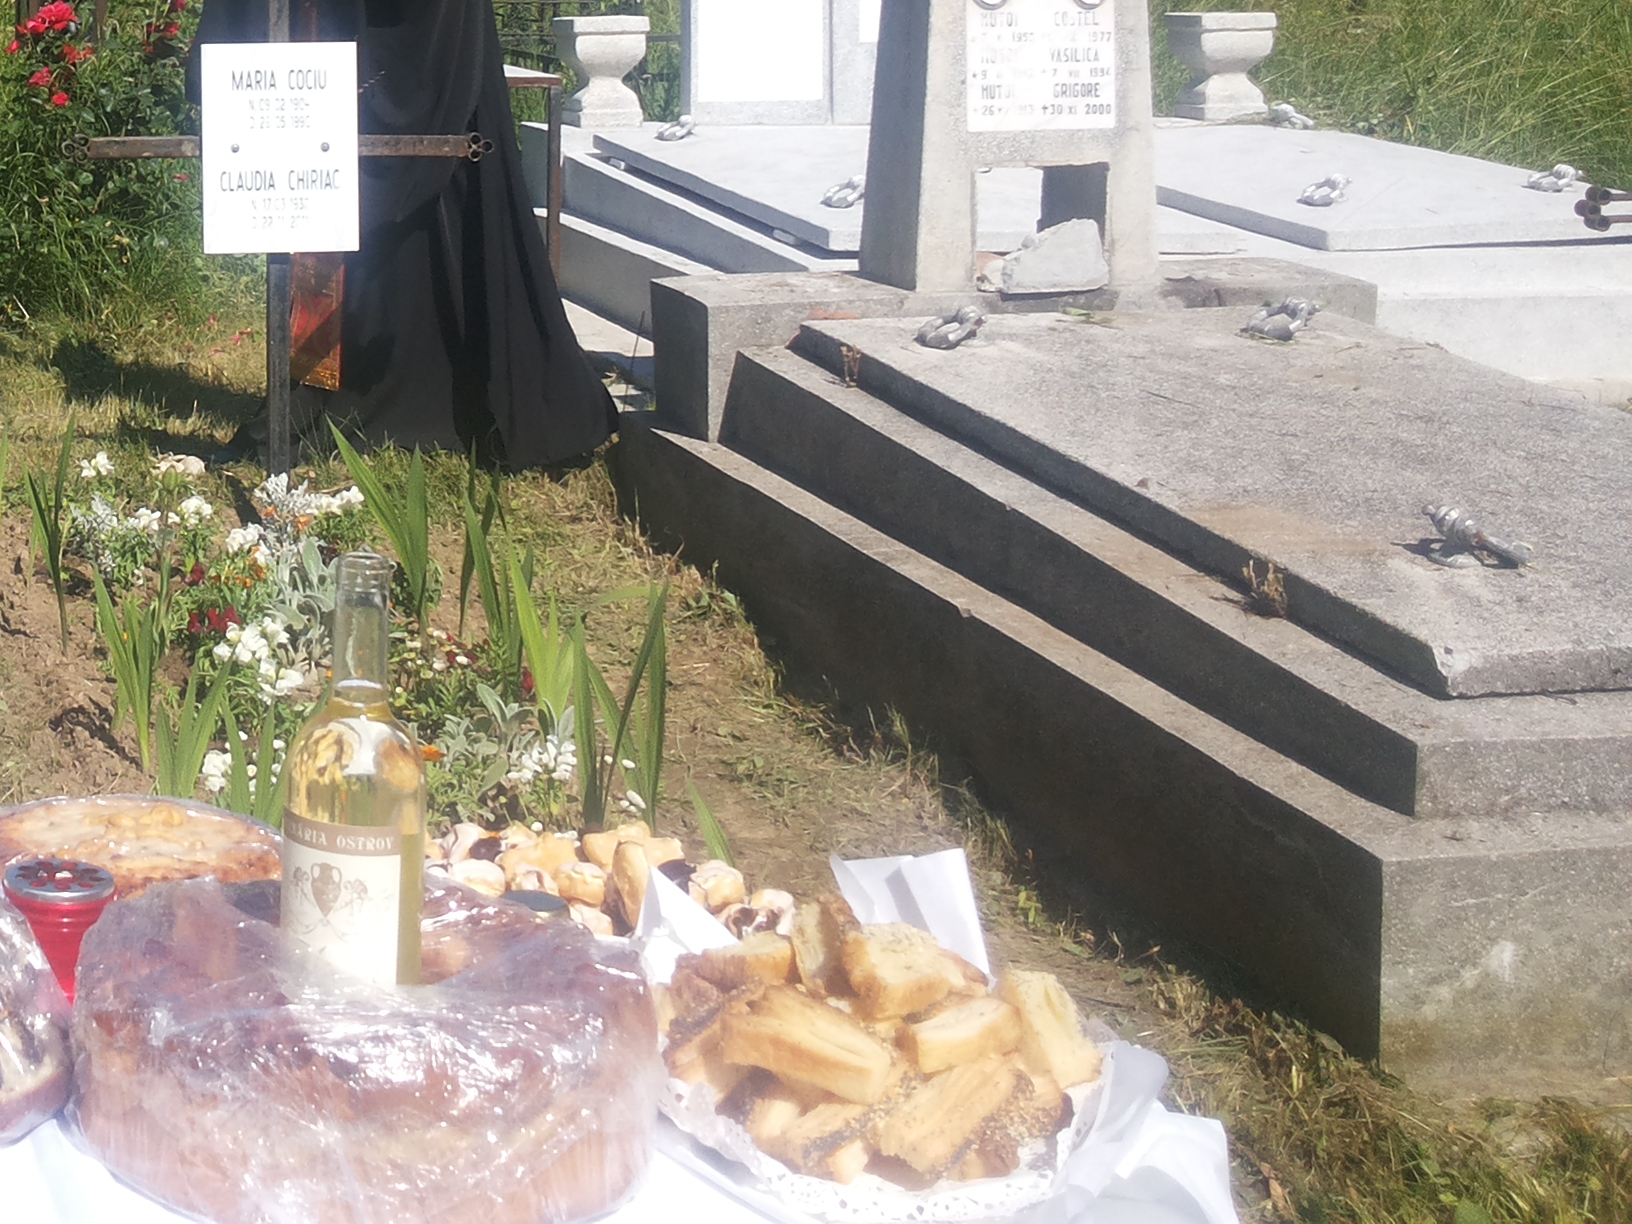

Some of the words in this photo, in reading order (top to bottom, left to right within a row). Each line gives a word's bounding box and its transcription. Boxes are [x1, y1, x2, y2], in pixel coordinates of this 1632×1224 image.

[1050, 47, 1100, 63] VASILICA
[231, 70, 277, 91] MARIA
[288, 69, 327, 90] COCIU
[1053, 82, 1101, 99] GRIGORE
[1084, 103, 1112, 115] 2000
[219, 170, 276, 192] CLAUDIA
[287, 169, 340, 191] CHIRIAC
[335, 834, 395, 851] OSTROV
